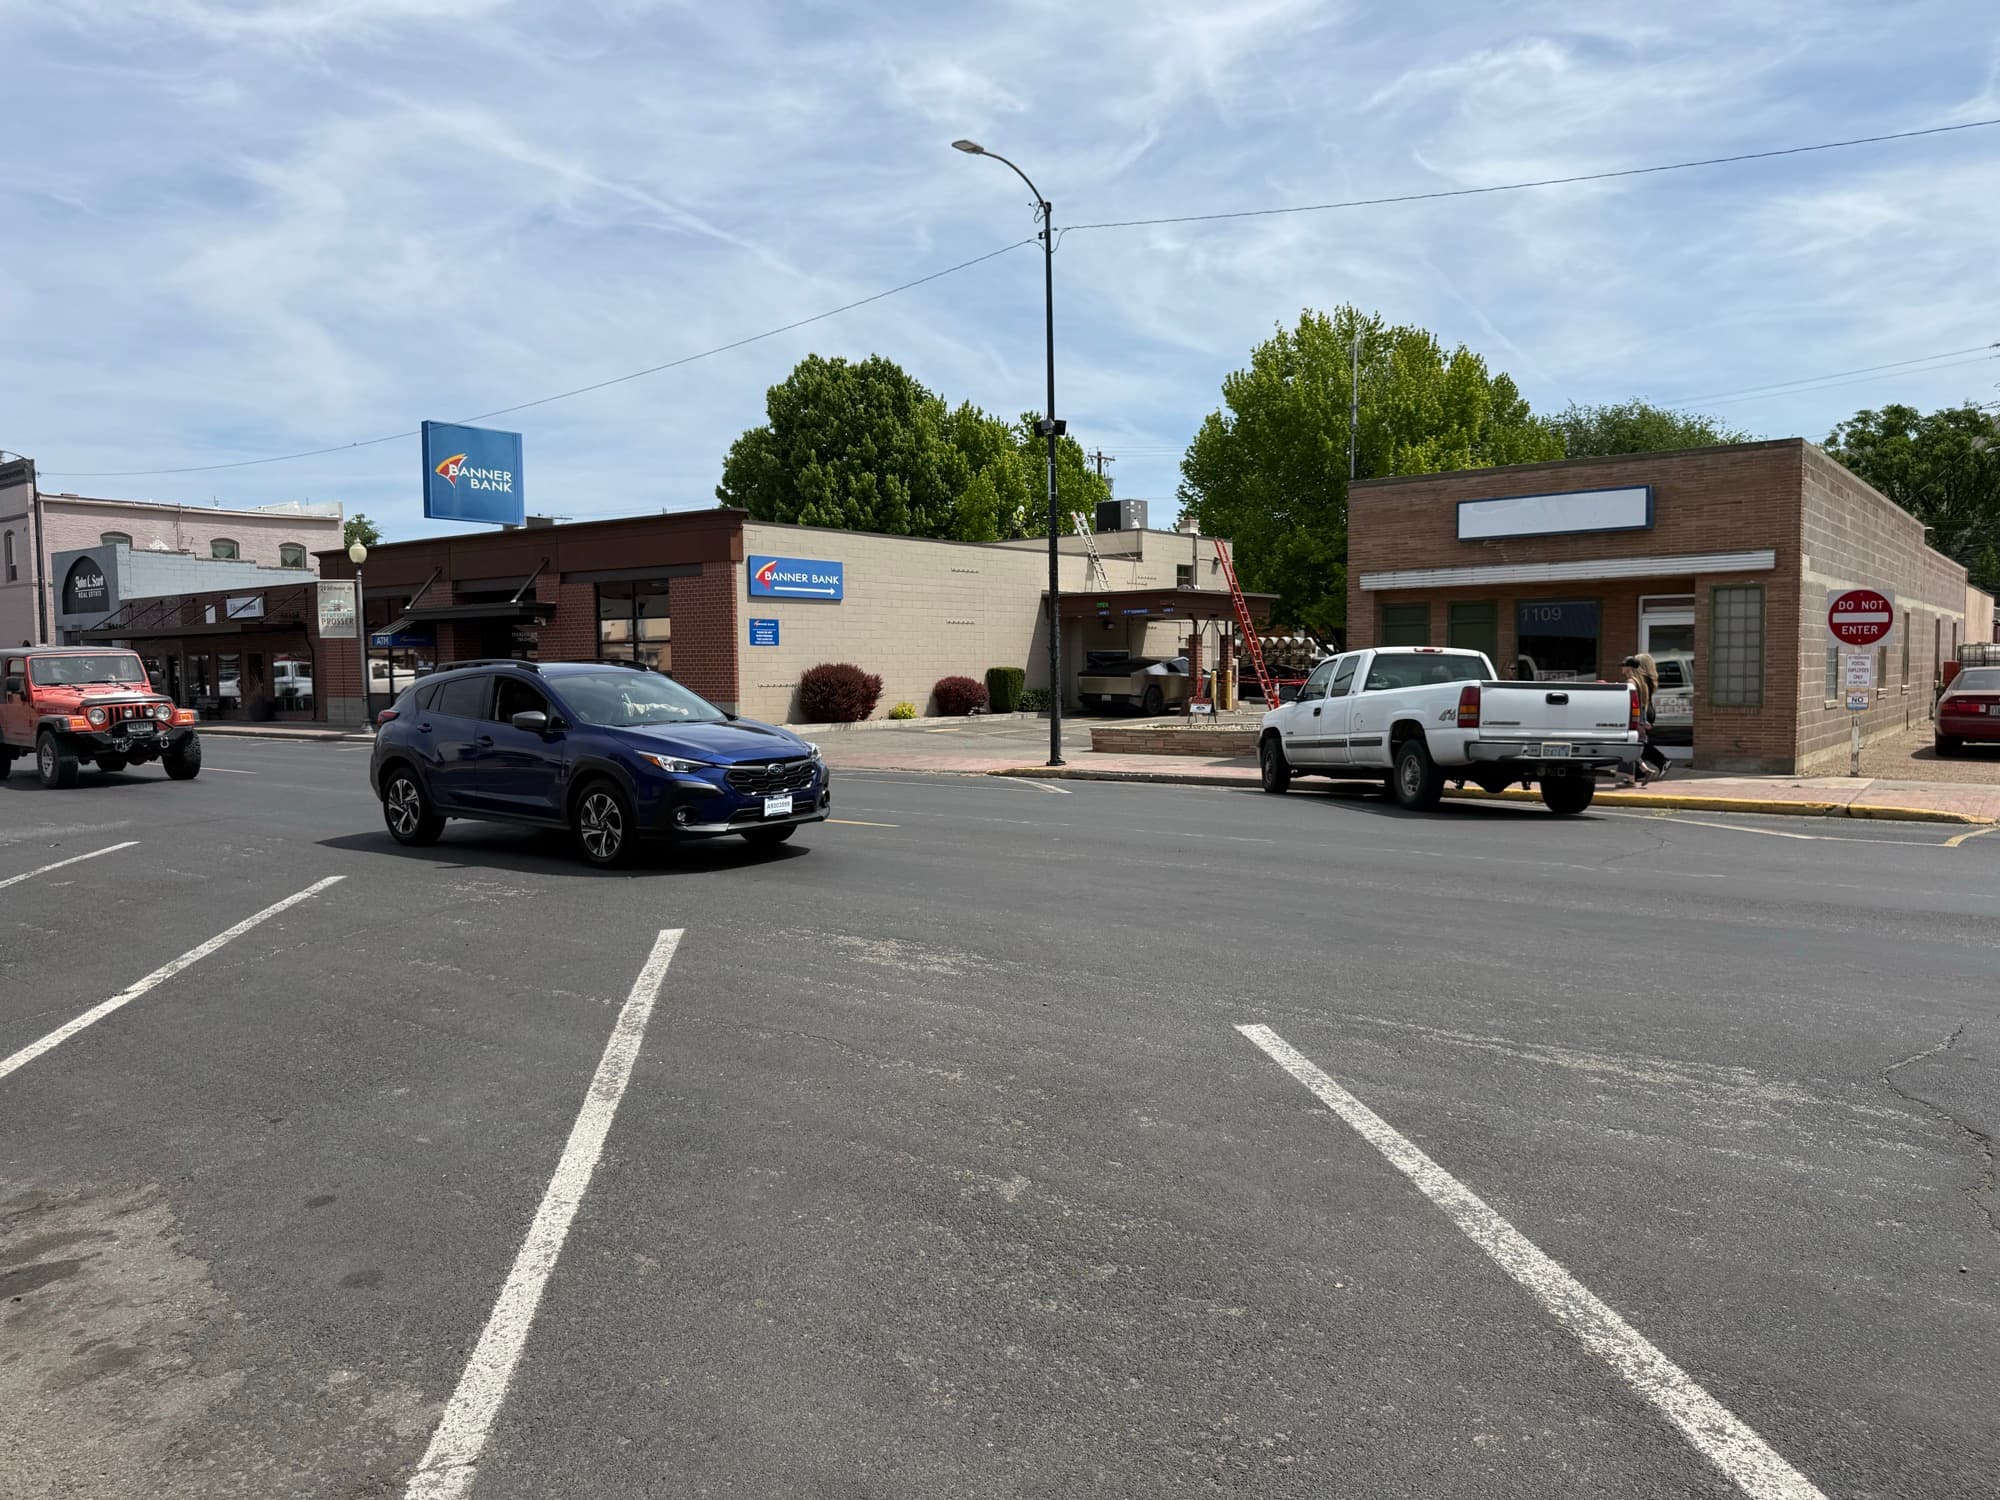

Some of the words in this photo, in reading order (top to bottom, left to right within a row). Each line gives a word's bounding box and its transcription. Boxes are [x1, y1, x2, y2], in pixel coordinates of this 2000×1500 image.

[449, 464, 512, 482] BANNER
[470, 479, 513, 493] BANK
[764, 571, 808, 583] BANNER
[811, 574, 839, 585] BANK
[1838, 601, 1854, 610] DO
[1861, 600, 1884, 610] NOT
[1520, 607, 1562, 622] 1109
[321, 618, 353, 626] PROSSER
[1841, 625, 1879, 635] ENTER
[376, 636, 390, 646] ATM
[1851, 696, 1864, 705] NO
